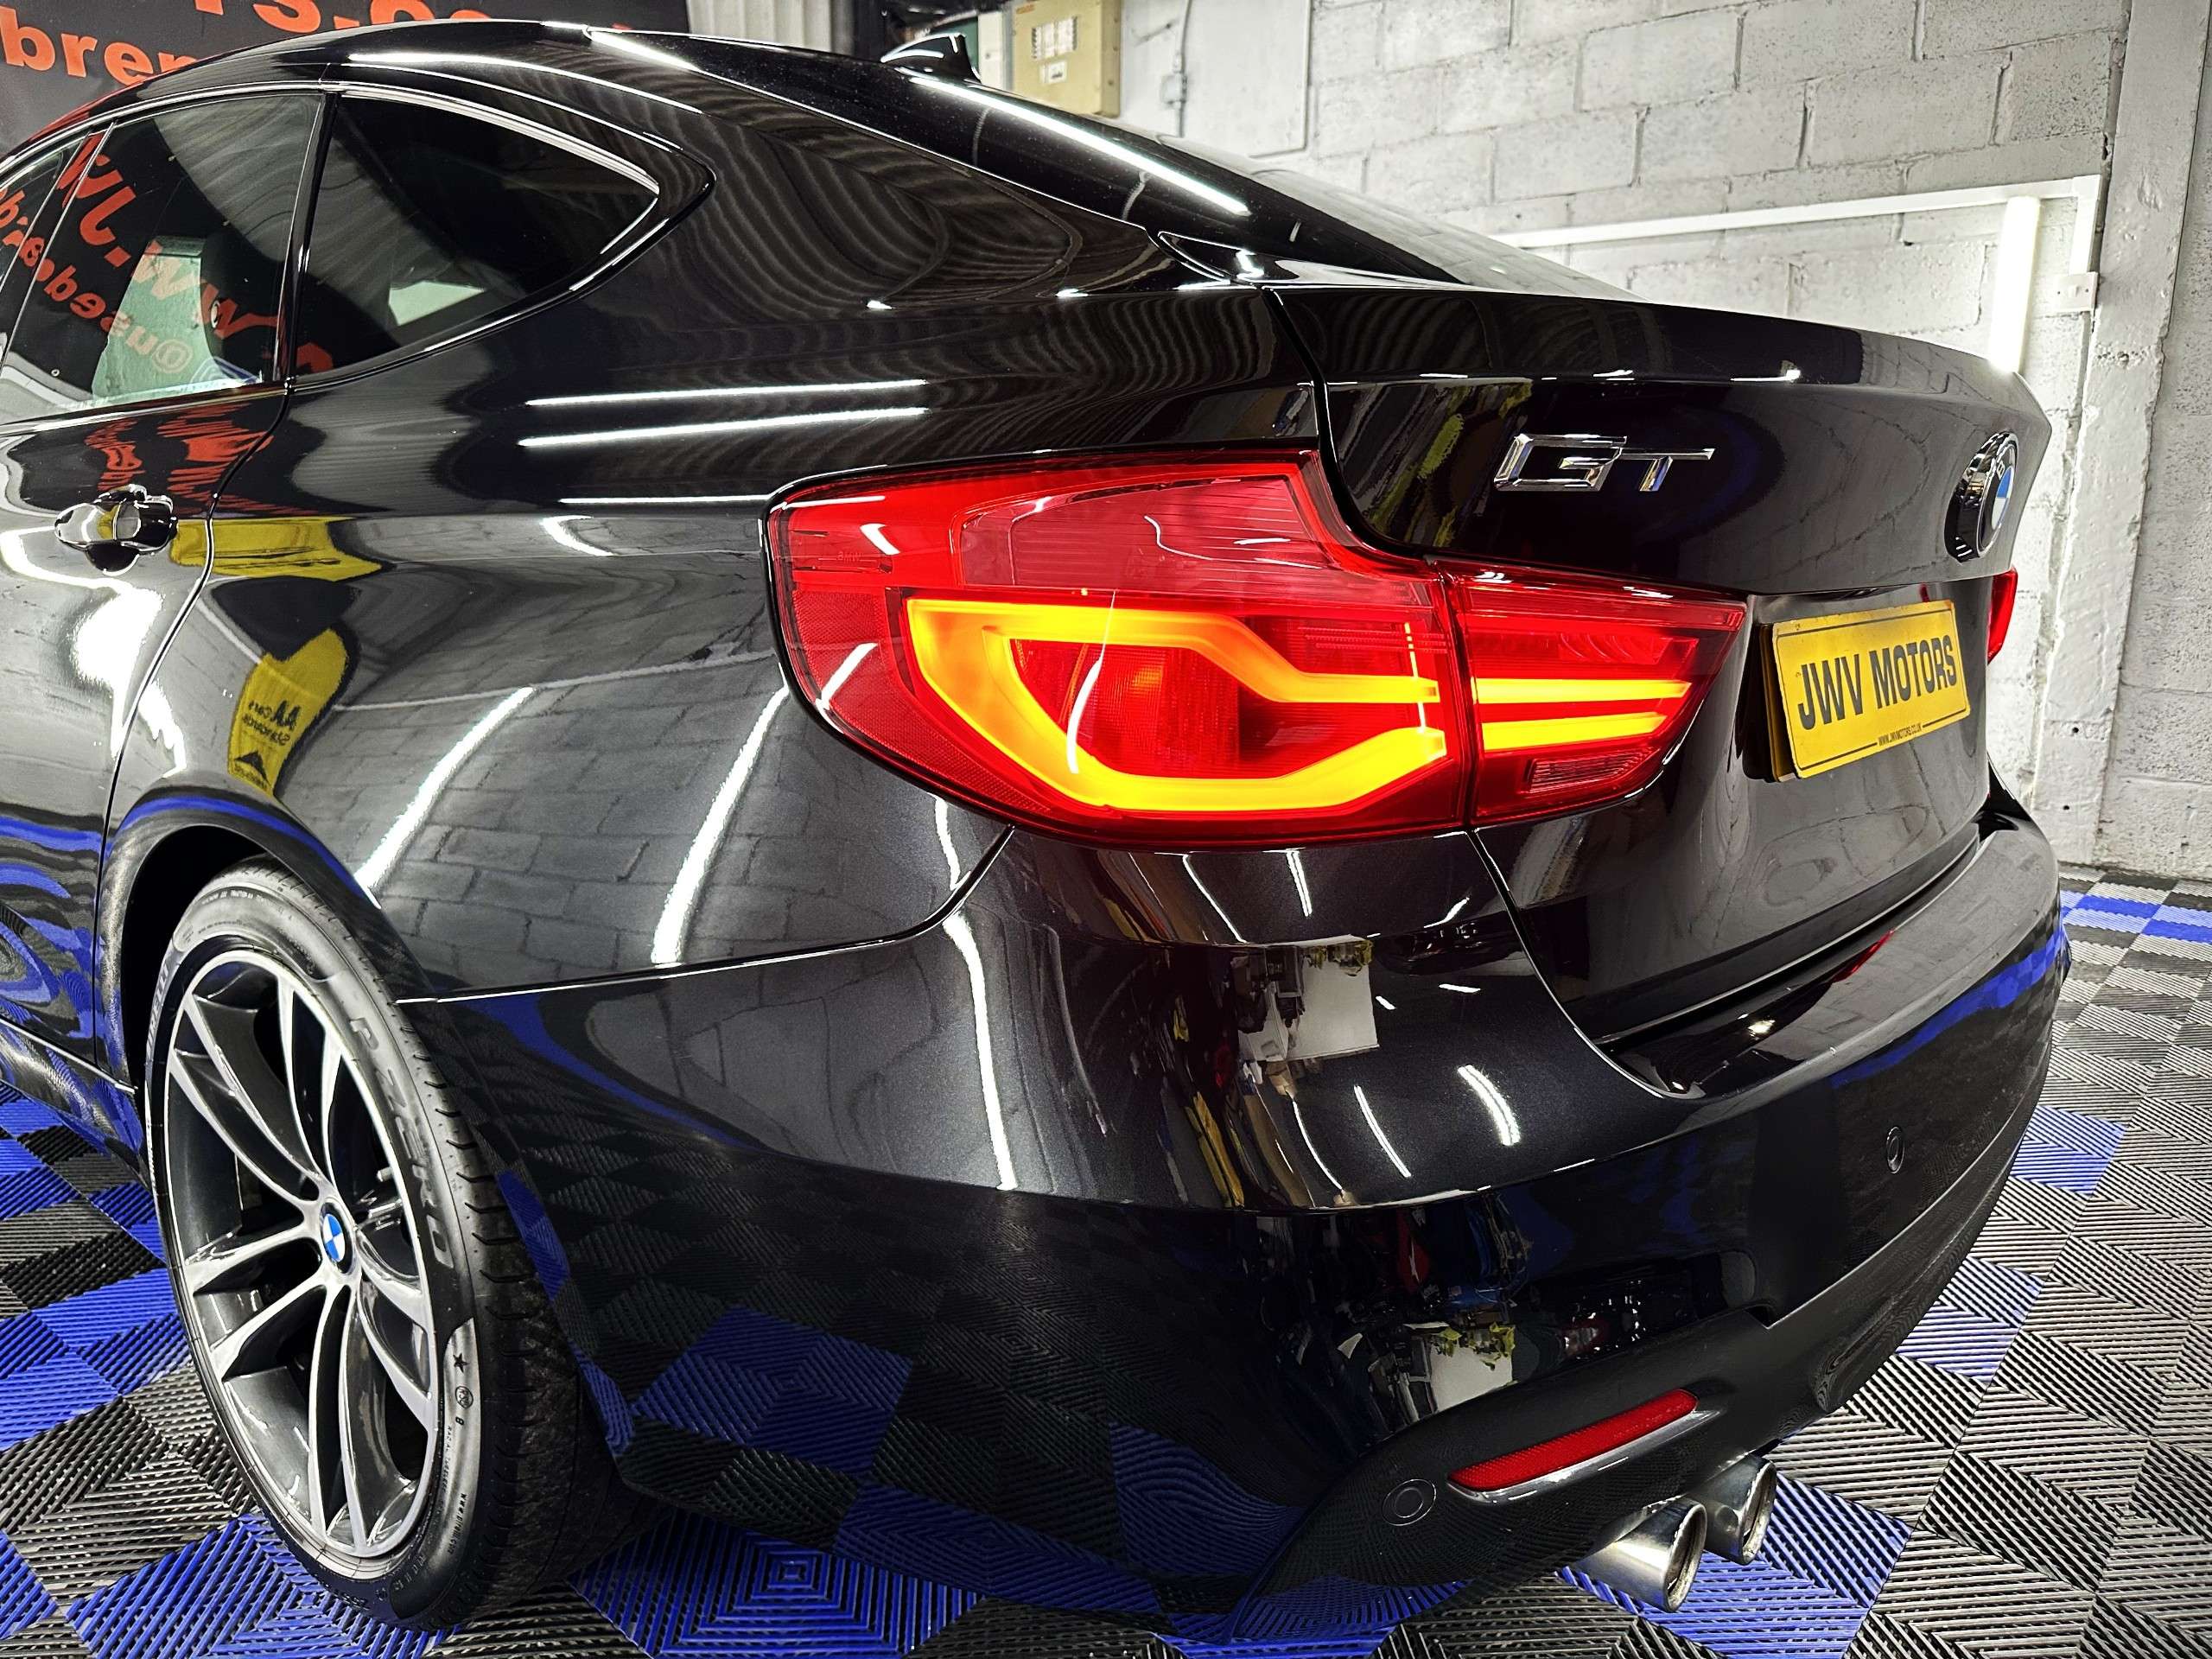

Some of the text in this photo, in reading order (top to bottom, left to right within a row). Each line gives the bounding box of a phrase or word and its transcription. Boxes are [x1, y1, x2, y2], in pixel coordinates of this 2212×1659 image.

[1493, 433, 1715, 492] GT
[1797, 635, 1957, 730] JWV MOTORS
[349, 1017, 454, 1268] P ZERO
